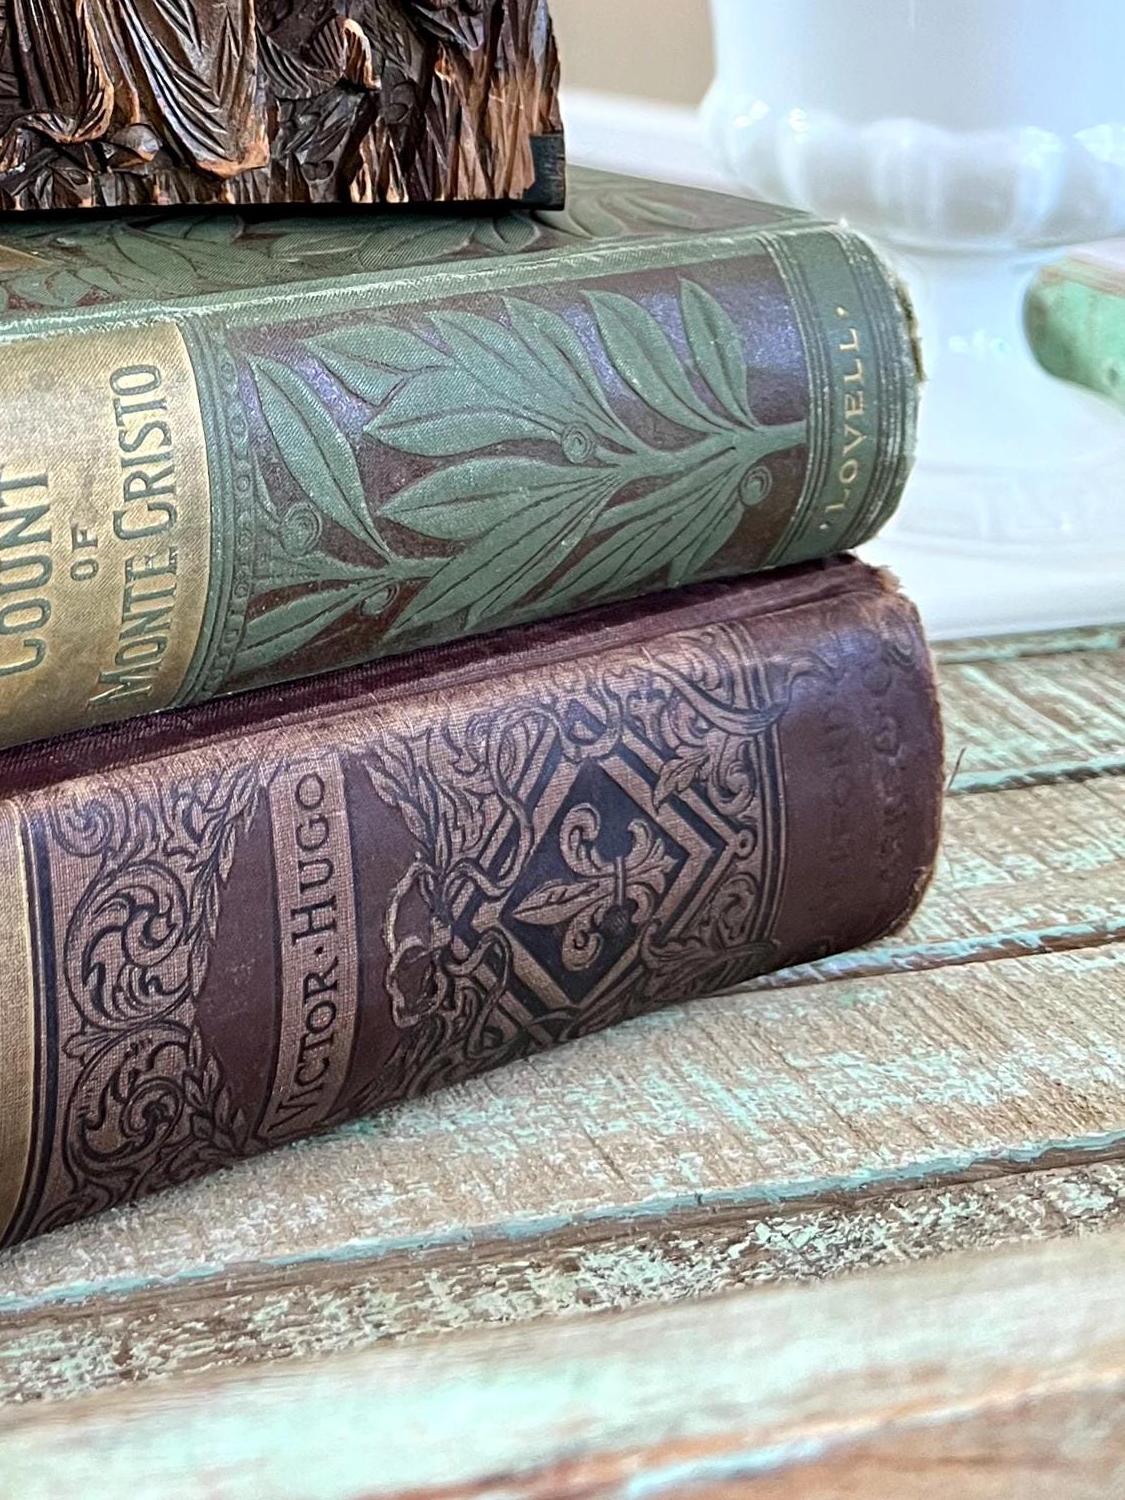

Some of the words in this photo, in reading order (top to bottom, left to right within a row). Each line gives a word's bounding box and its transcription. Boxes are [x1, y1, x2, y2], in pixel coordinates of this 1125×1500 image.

[111, 362, 177, 542] CRISTO
[68, 523, 100, 583] OF
[89, 545, 179, 708] MONTE
